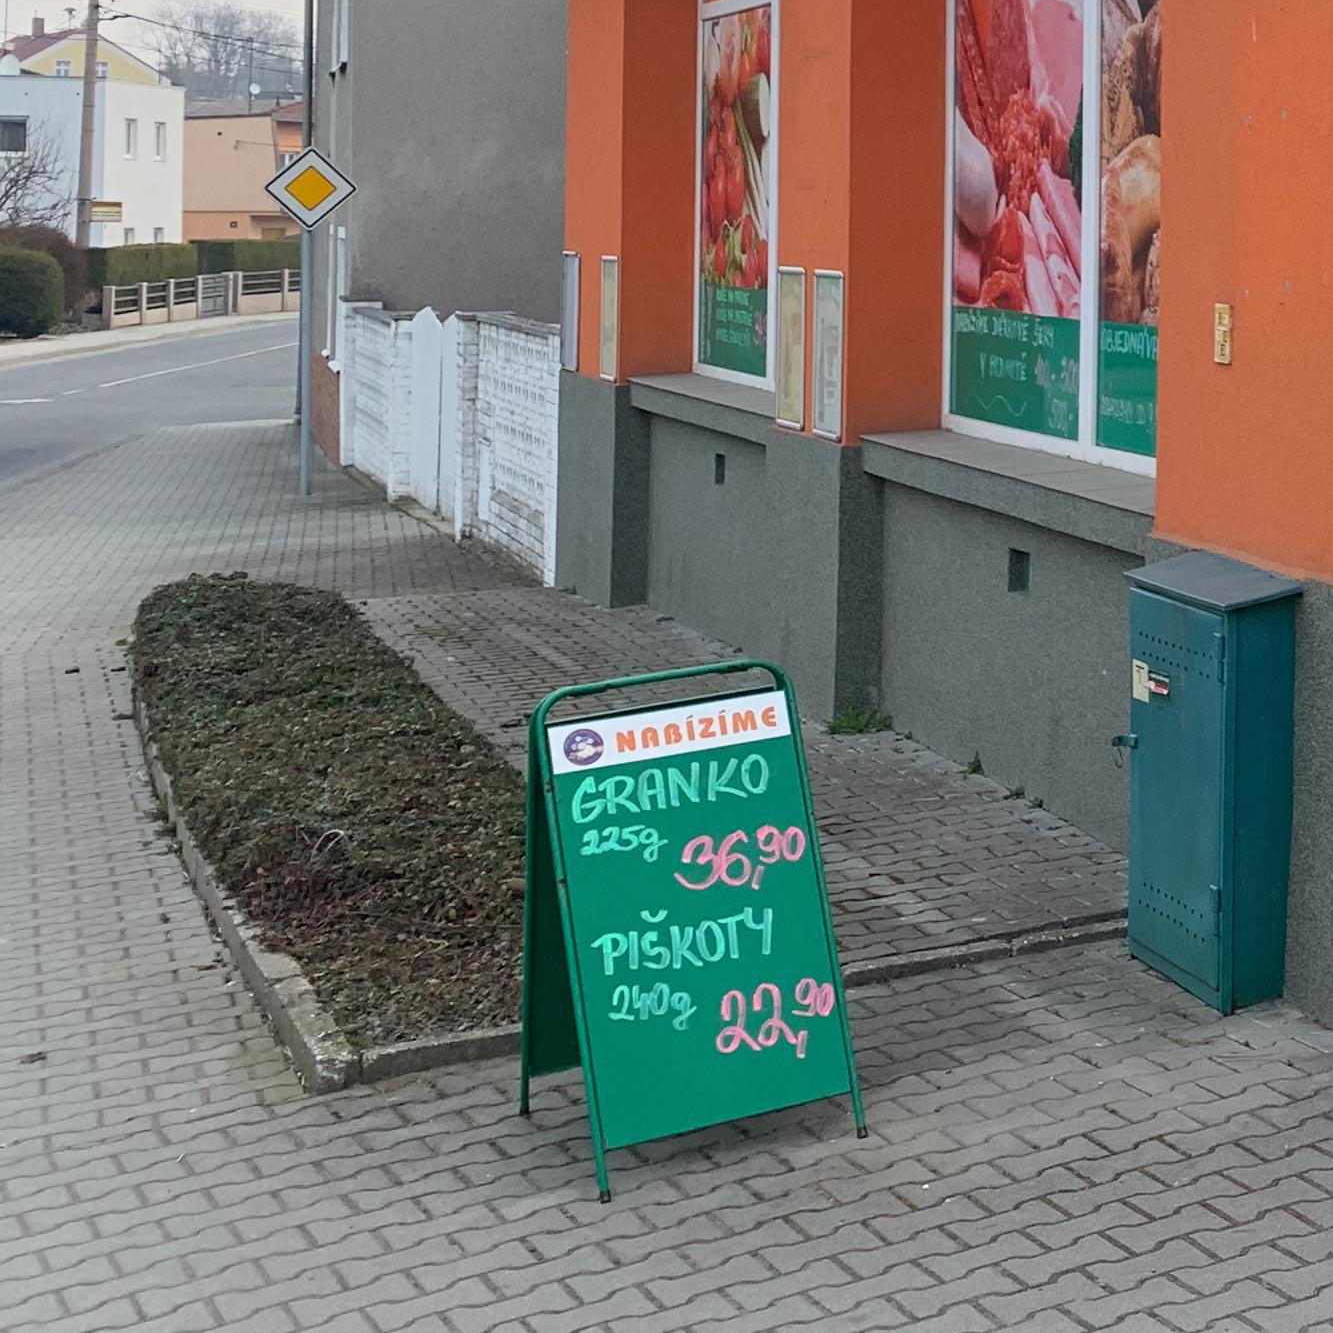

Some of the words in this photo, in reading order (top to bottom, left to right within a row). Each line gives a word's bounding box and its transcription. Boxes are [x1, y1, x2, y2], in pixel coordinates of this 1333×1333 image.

[615, 704, 778, 754] NABÍZÍME
[570, 753, 770, 824] GRANKO
[580, 824, 668, 863] 225g
[590, 906, 775, 976] PIŠKOTY
[609, 981, 697, 1031] 240g
